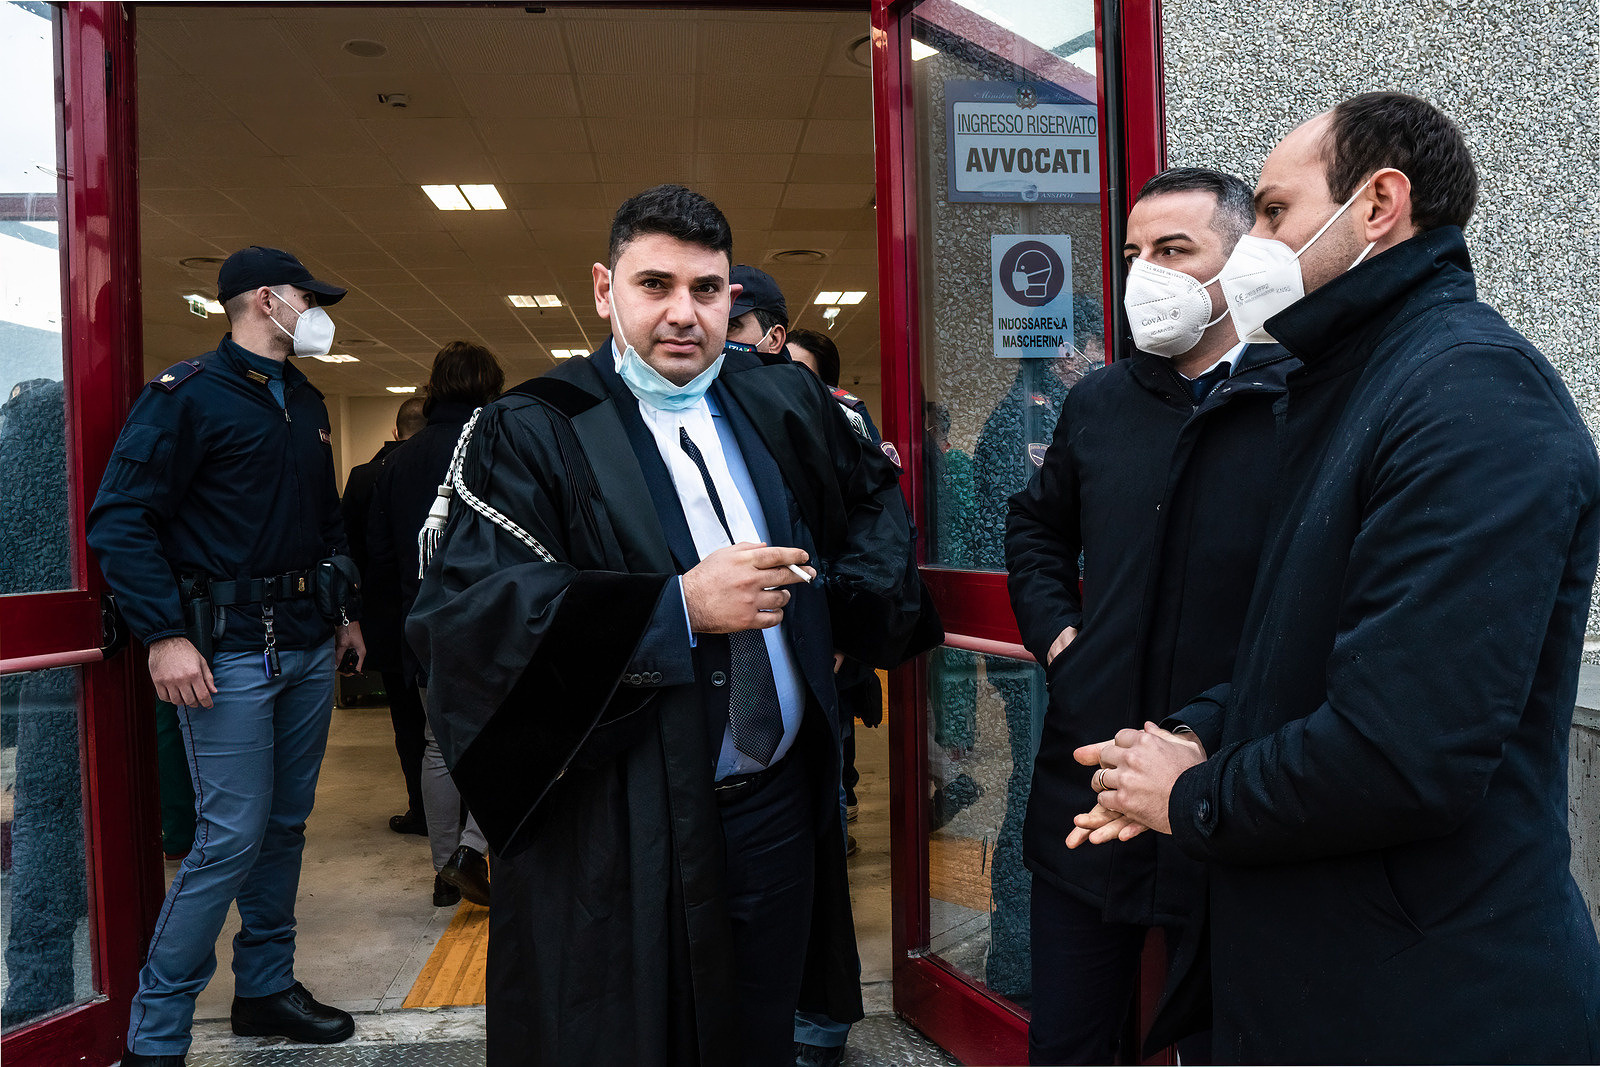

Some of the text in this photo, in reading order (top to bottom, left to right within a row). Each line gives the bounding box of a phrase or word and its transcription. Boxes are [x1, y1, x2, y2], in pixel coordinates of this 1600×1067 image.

[957, 113, 1097, 135] INGRESSO RISERVATO
[965, 147, 1090, 174] AVVOCATI
[998, 317, 1053, 330] INDOSSARE
[1002, 335, 1065, 348] MASCHERINA
